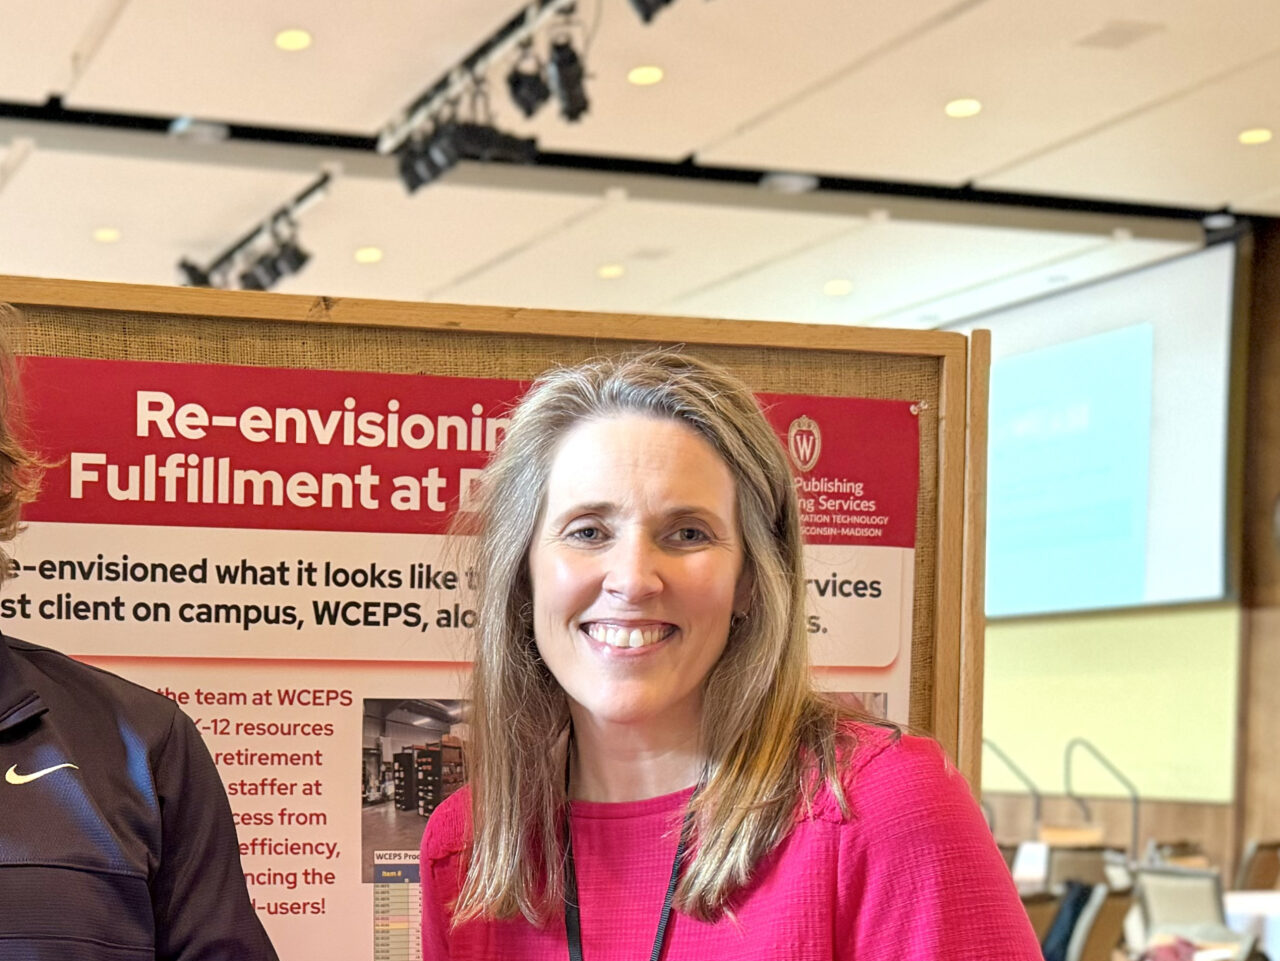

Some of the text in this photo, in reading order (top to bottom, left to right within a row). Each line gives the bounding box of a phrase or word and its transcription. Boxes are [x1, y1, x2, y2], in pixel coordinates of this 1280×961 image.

[136, 390, 512, 452] Re-envisionin
[70, 451, 379, 510] Fulfillment
[390, 467, 447, 512] at
[794, 477, 864, 497] Publishing
[819, 495, 876, 512] Services
[800, 514, 889, 525] ATION TECHNOLOGY
[8, 553, 207, 585] e-envisioned
[216, 558, 289, 587] what
[296, 559, 318, 588] it
[324, 561, 402, 590] looks
[410, 563, 458, 591] like
[804, 572, 882, 598] rvices
[38, 592, 125, 622] client
[132, 601, 171, 623] on
[178, 602, 304, 631] campus,
[312, 601, 429, 633] WCEPS,
[436, 603, 477, 629] alo
[194, 690, 248, 706] team
[251, 690, 273, 706] at
[277, 689, 353, 707] WCEPS
[235, 720, 334, 737] resources
[215, 750, 323, 766] retirement
[228, 779, 323, 796] staffer at
[233, 808, 327, 826] cess from
[239, 839, 341, 859] efficiency,
[244, 868, 336, 890] ncing the
[251, 898, 326, 915] -users!
